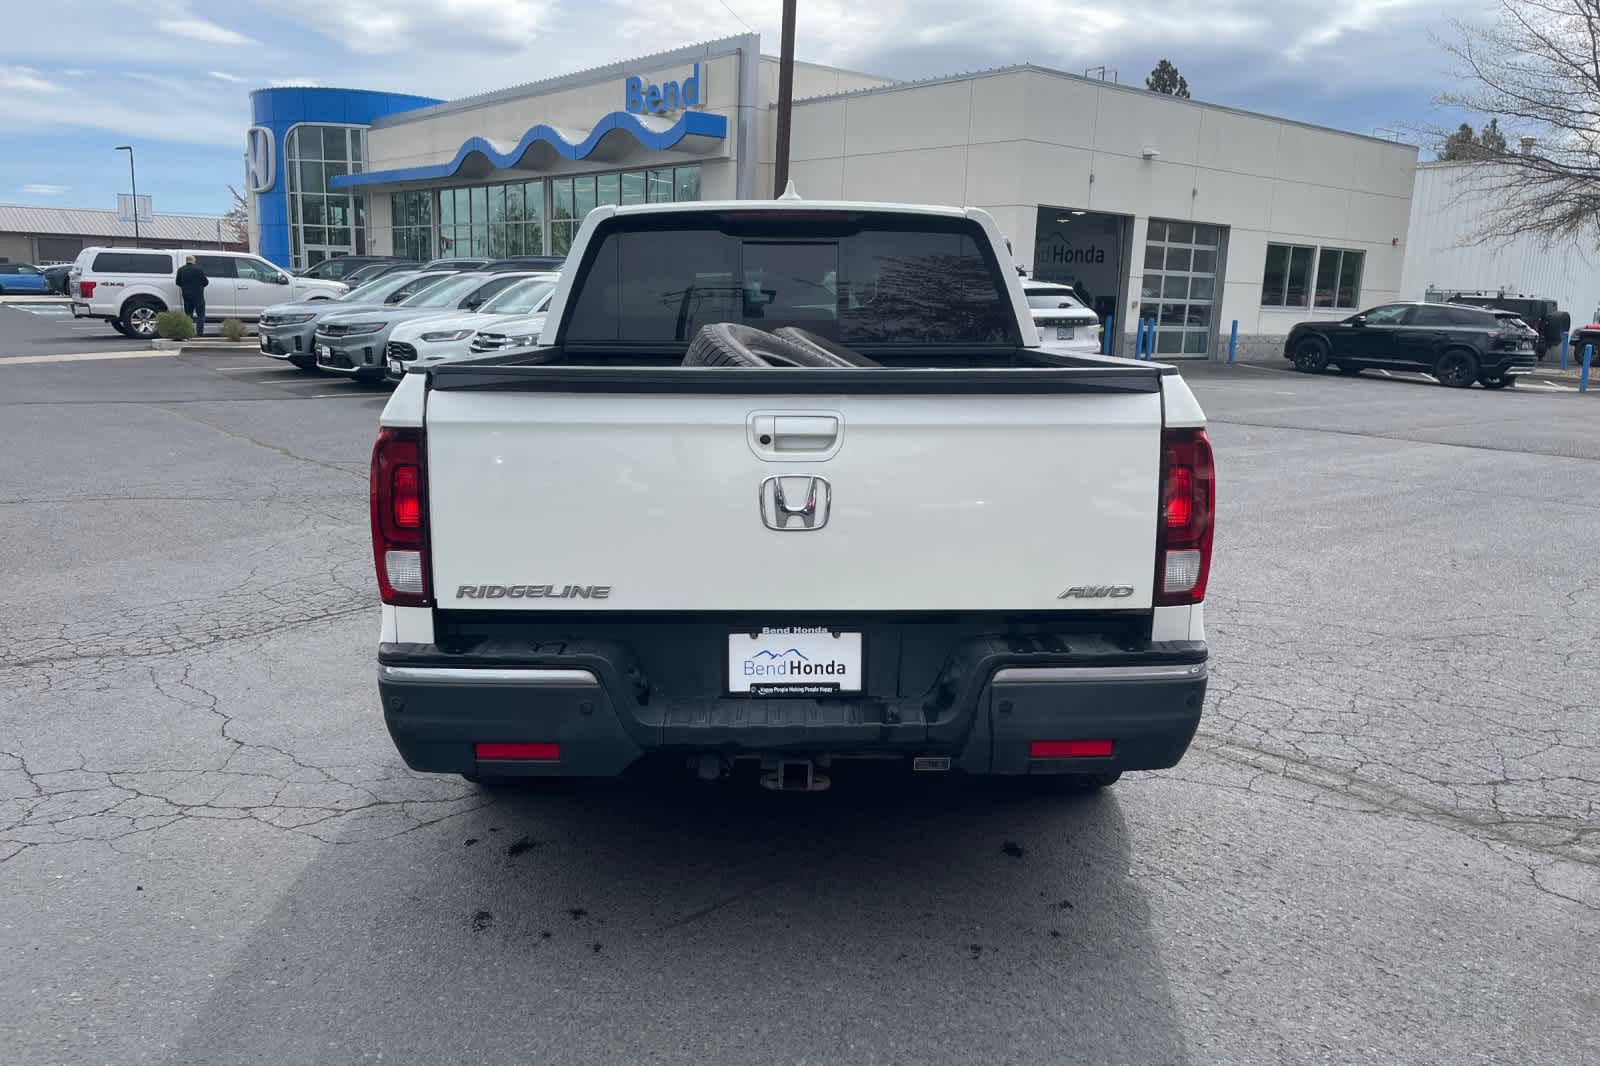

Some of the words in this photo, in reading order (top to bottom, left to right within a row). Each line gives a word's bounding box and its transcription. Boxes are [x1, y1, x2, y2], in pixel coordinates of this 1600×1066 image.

[625, 63, 699, 113] Bend
[1052, 243, 1105, 264] Honda
[456, 584, 611, 599] RIDGELINE
[1057, 584, 1134, 599] AWD
[762, 626, 791, 635] Bend
[793, 626, 829, 634] Honda
[744, 660, 787, 676] Bend
[790, 660, 846, 675] Honda
